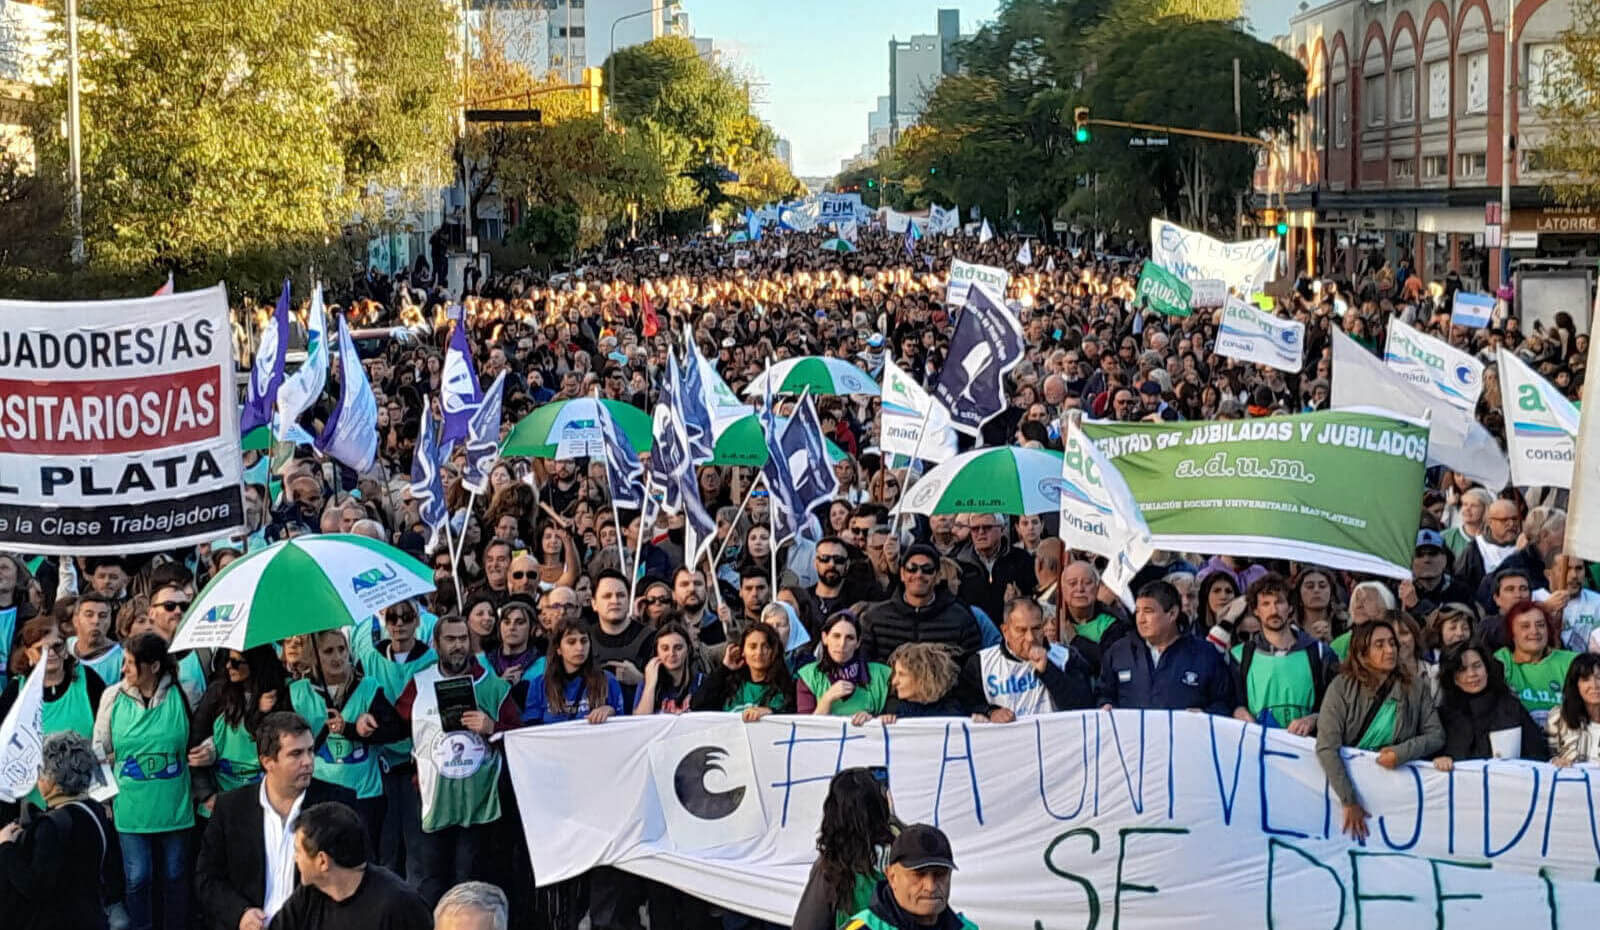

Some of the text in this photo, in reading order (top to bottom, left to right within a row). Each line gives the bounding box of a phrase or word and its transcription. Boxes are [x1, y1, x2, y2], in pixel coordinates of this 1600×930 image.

[823, 202, 854, 213] FUM
[0, 383, 215, 441] SITARIOS/AS
[1185, 422, 1293, 445] JUBILADAS
[1300, 422, 1315, 443] Y
[1317, 423, 1428, 463] JUBILADOS
[1526, 448, 1576, 461] conad
[40, 449, 224, 496] PLATA
[1175, 452, 1316, 484] a.d.u.m.
[16, 515, 33, 533] la
[41, 516, 101, 535] Clase
[110, 503, 230, 533] Trabajadora
[987, 671, 1038, 698] Suteb
[1266, 837, 1600, 930] DEFI
